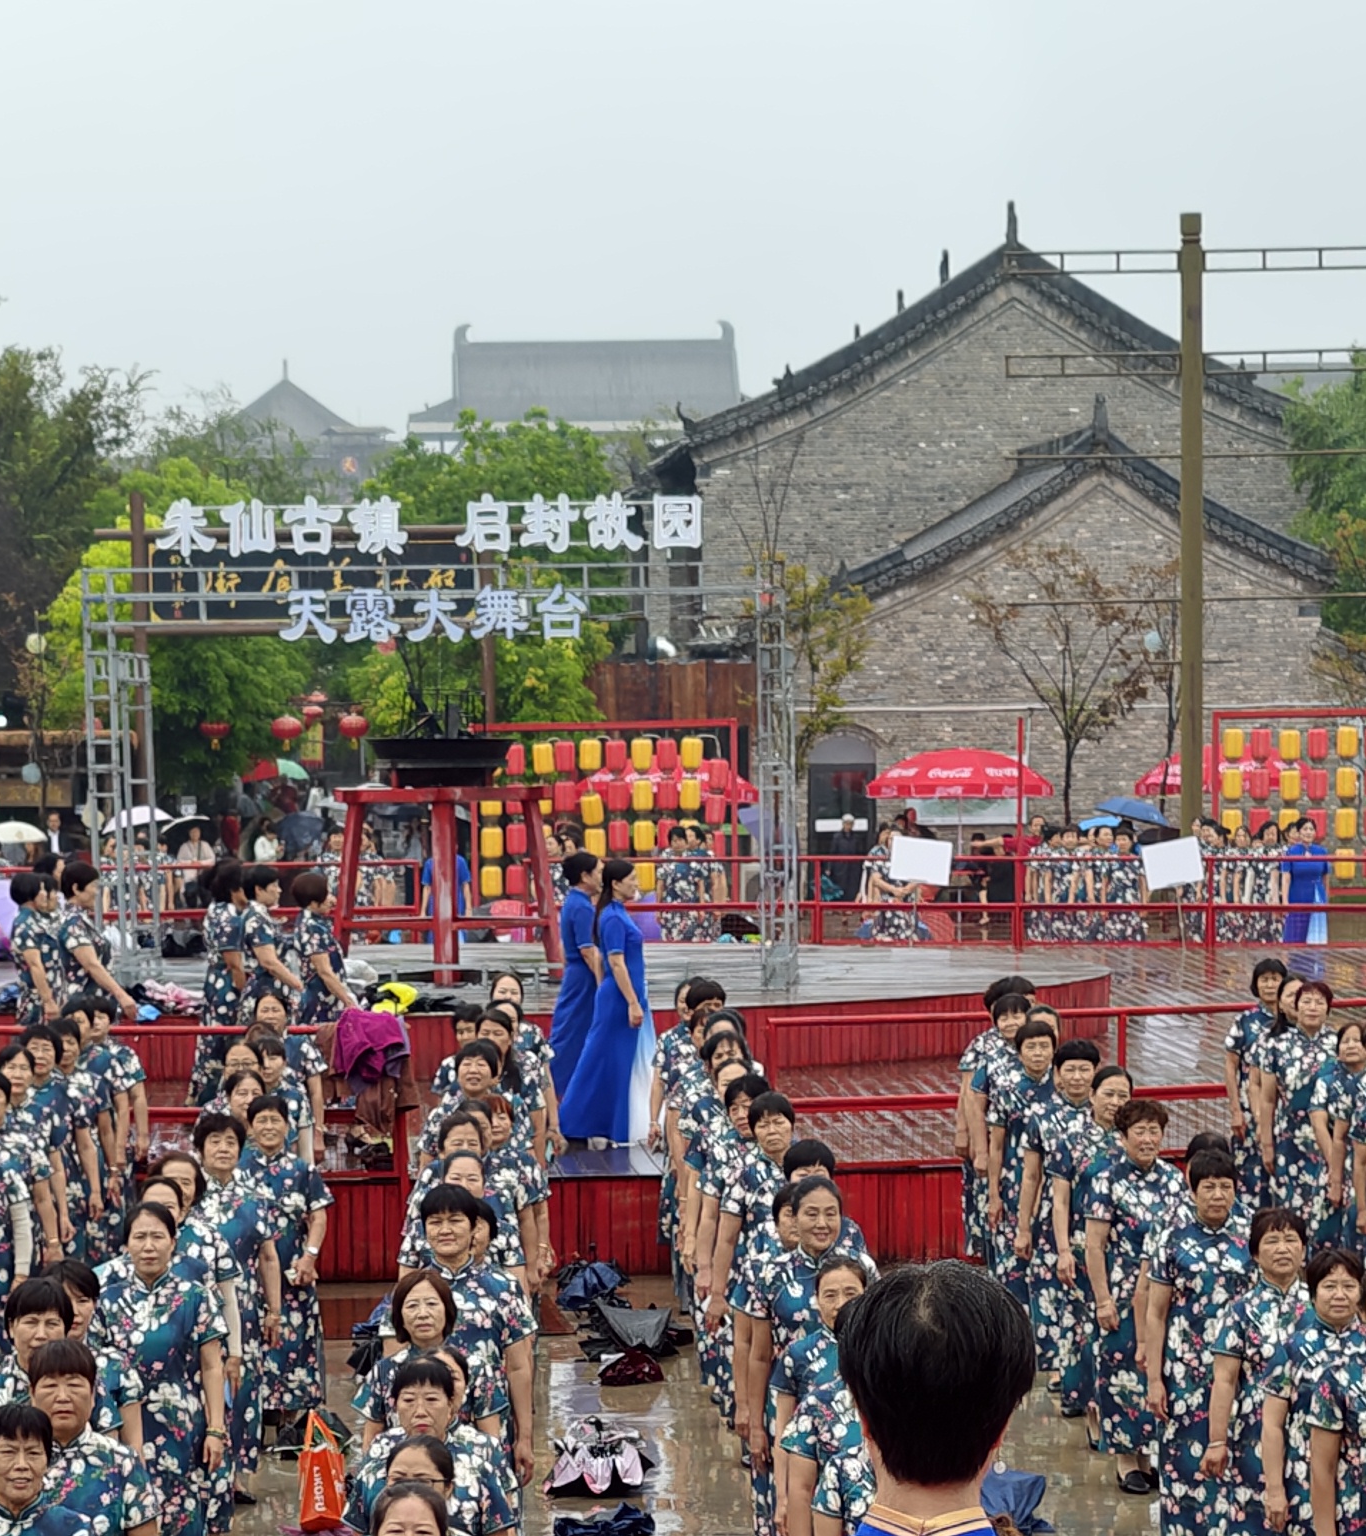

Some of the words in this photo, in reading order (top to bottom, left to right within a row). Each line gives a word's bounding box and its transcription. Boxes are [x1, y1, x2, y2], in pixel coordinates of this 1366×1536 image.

[156, 494, 408, 558] 朱仙古镇
[455, 493, 703, 553] 启封故园
[279, 583, 588, 645] 天露大舞台
